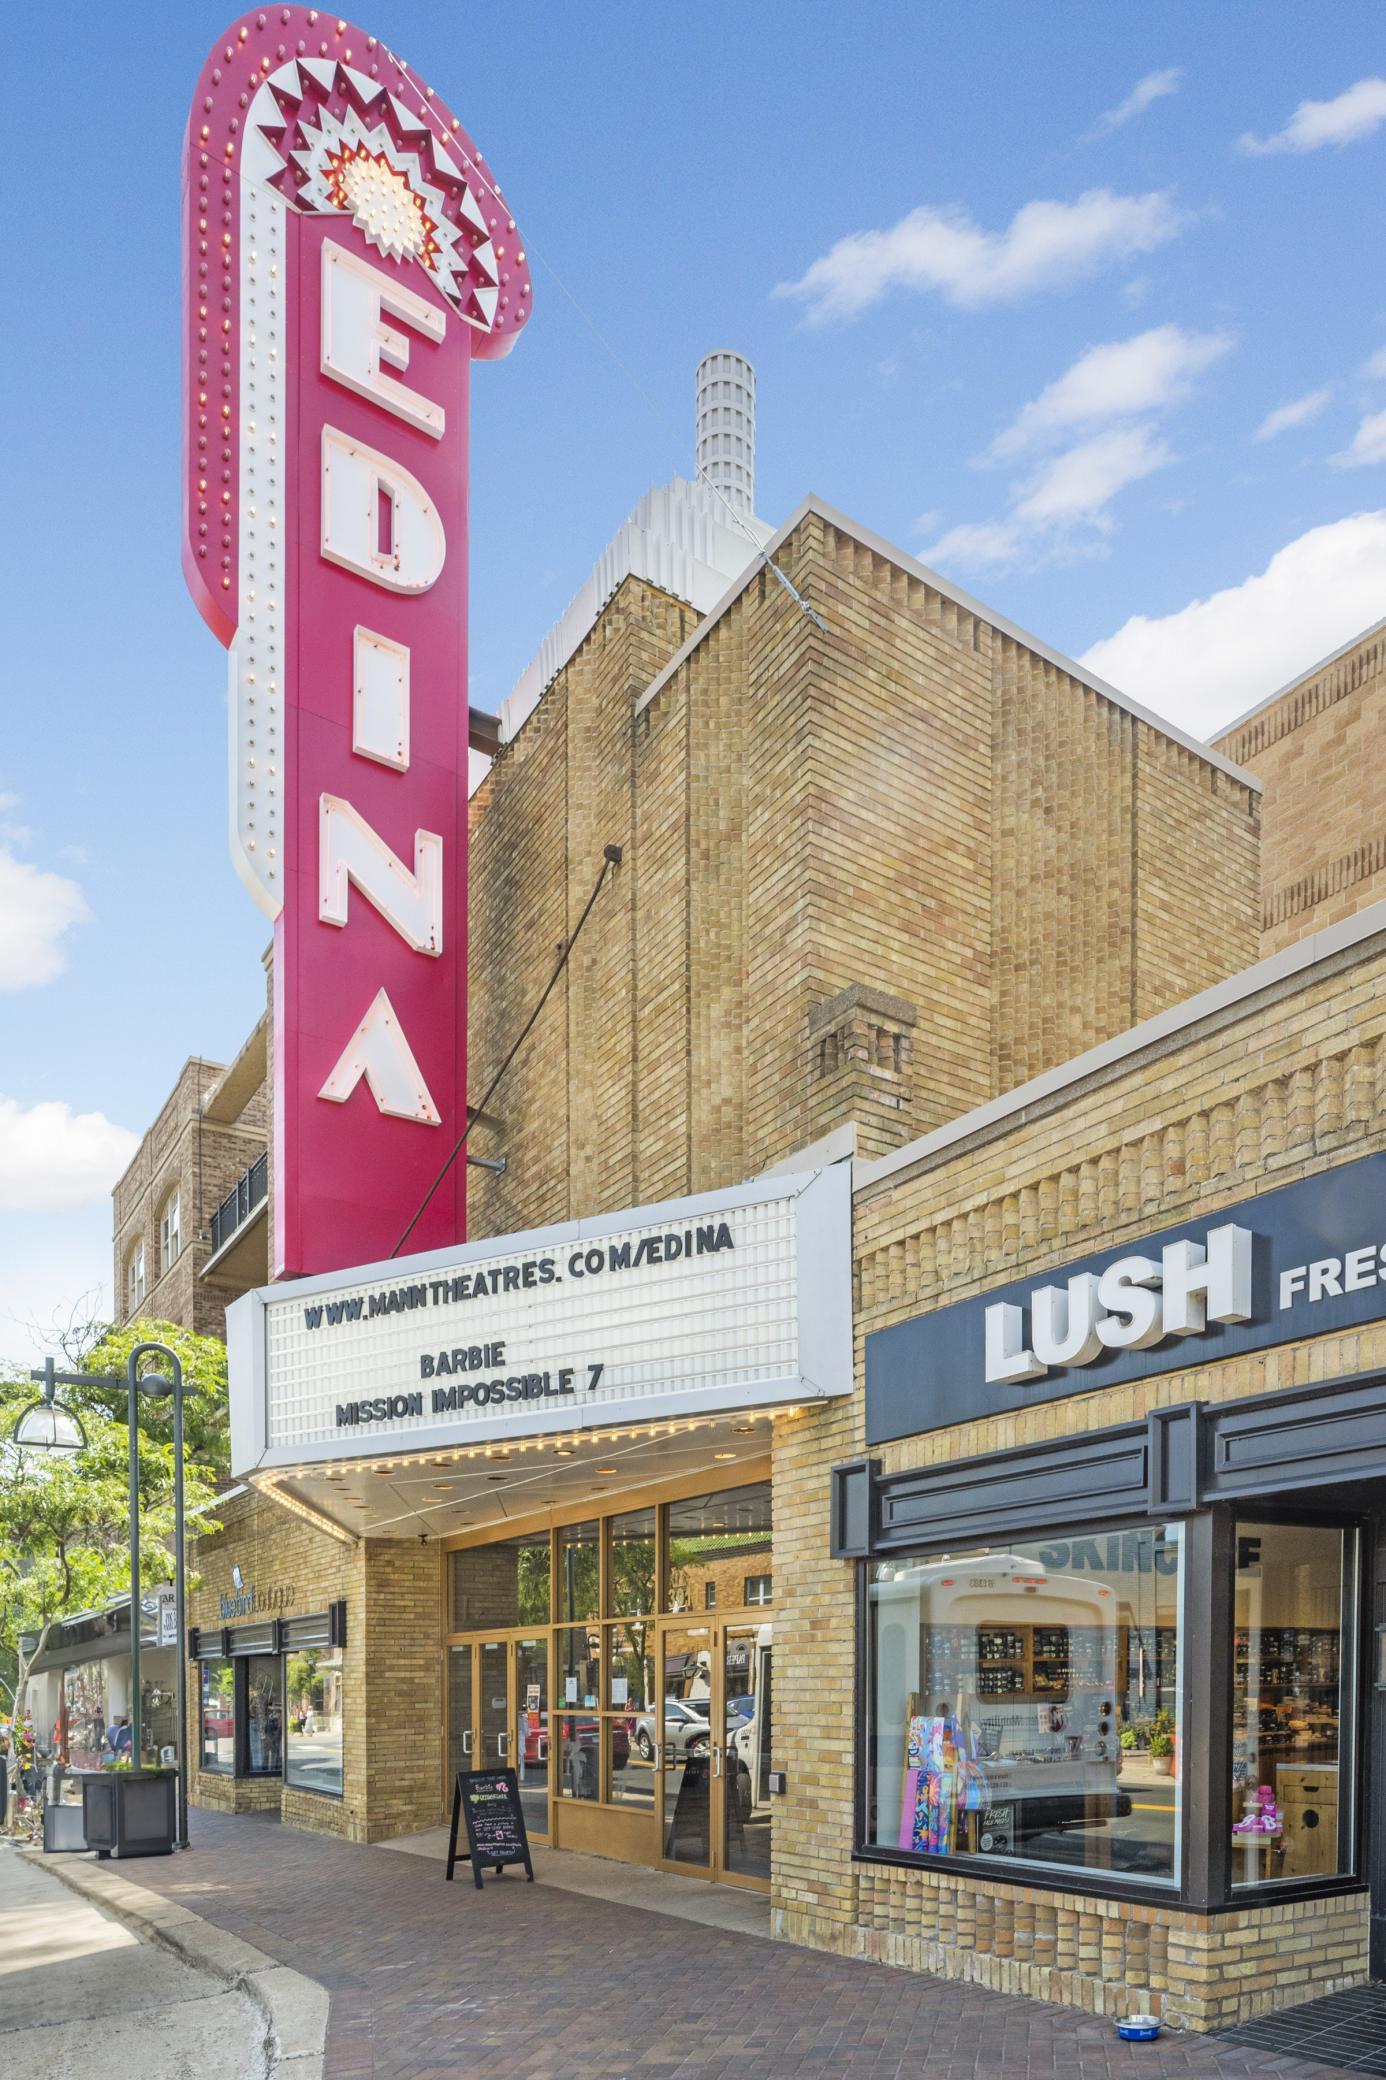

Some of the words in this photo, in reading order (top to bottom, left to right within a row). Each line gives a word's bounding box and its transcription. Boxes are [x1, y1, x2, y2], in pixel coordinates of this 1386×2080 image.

[317, 237, 446, 1126] EDINA
[420, 1341, 506, 1378] BARBIE
[985, 1223, 1252, 1384] LUSH
[336, 1391, 423, 1426] MISSION
[431, 1368, 574, 1413] IMPOSSIBLE
[588, 1363, 604, 1390] 7
